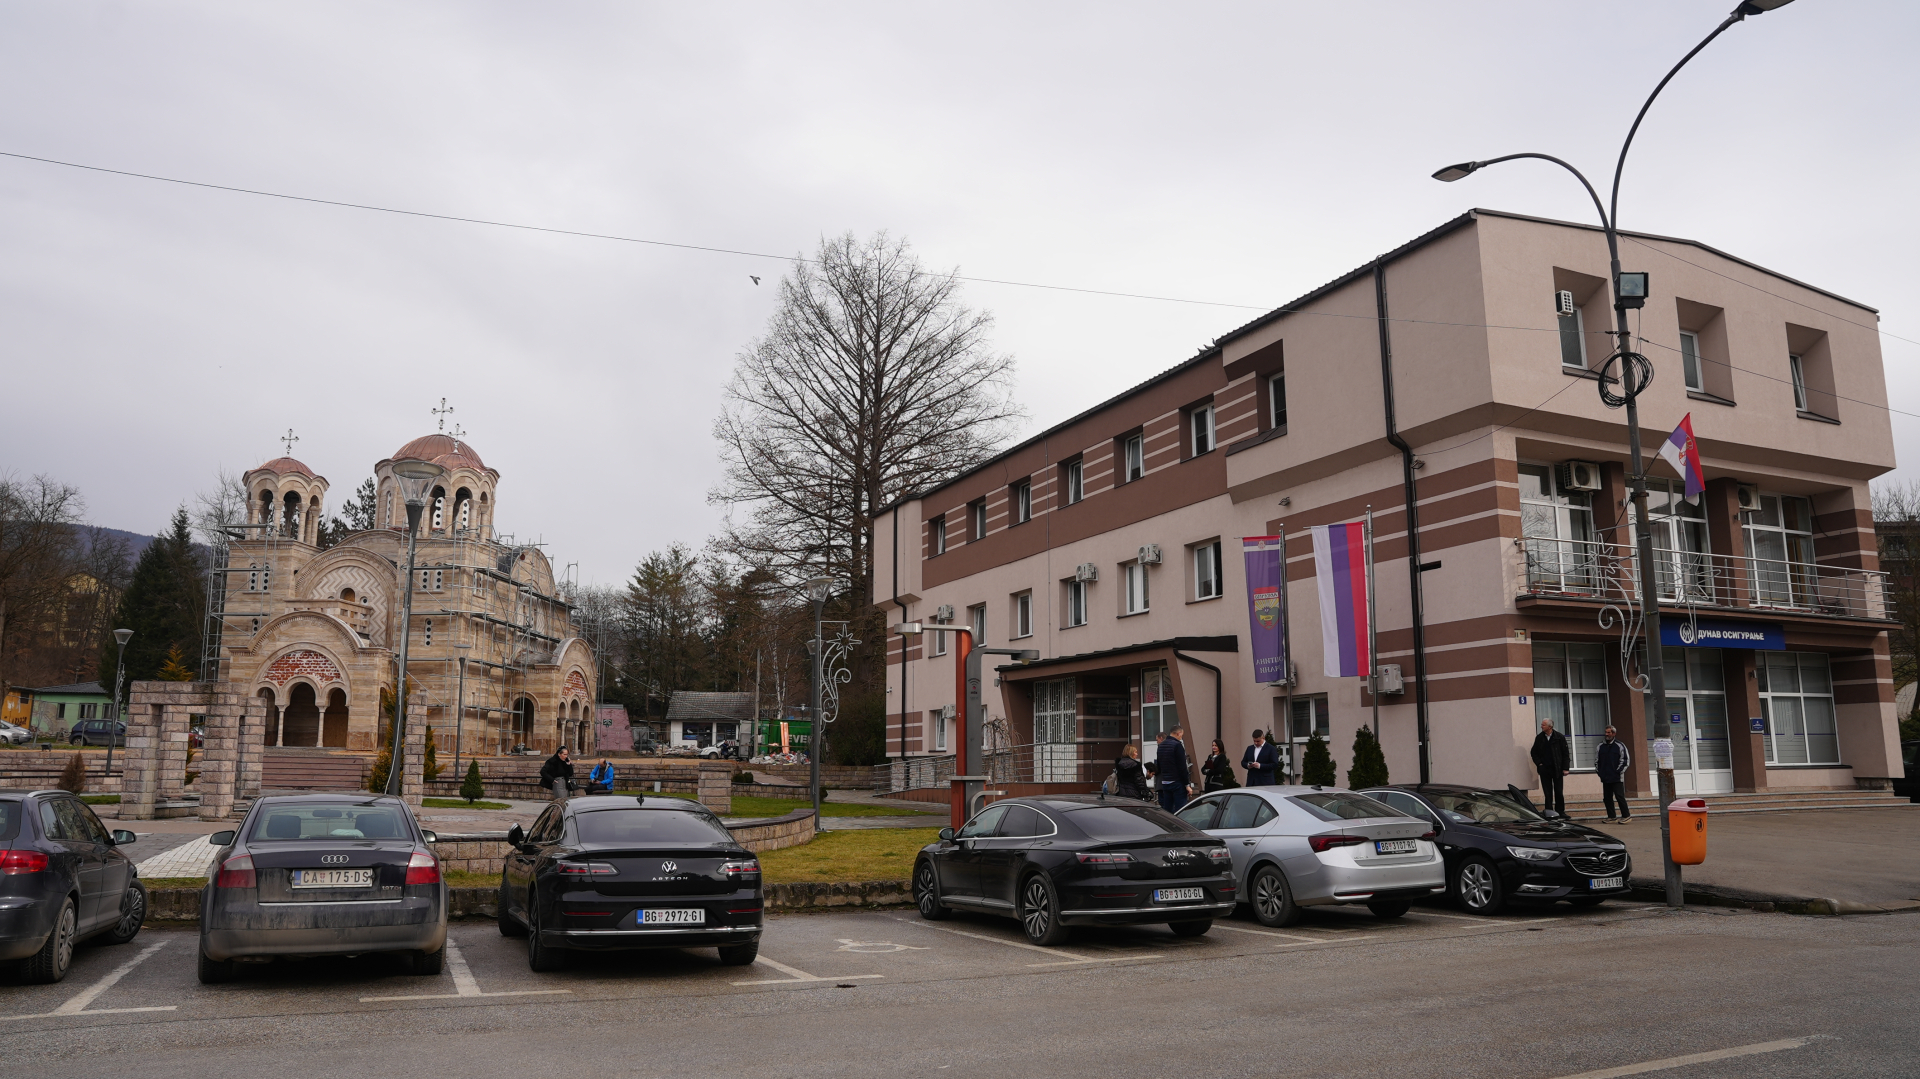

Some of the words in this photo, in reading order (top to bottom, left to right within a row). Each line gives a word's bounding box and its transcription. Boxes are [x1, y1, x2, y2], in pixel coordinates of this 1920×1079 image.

[1697, 629, 1722, 639] ДУНАВ
[1722, 631, 1765, 641] ОСИГУРАЊЕ
[303, 870, 318, 883] ČA
[1159, 890, 1169, 900] BG
[645, 911, 657, 922] BG
[665, 910, 702, 922] 2972-GI
